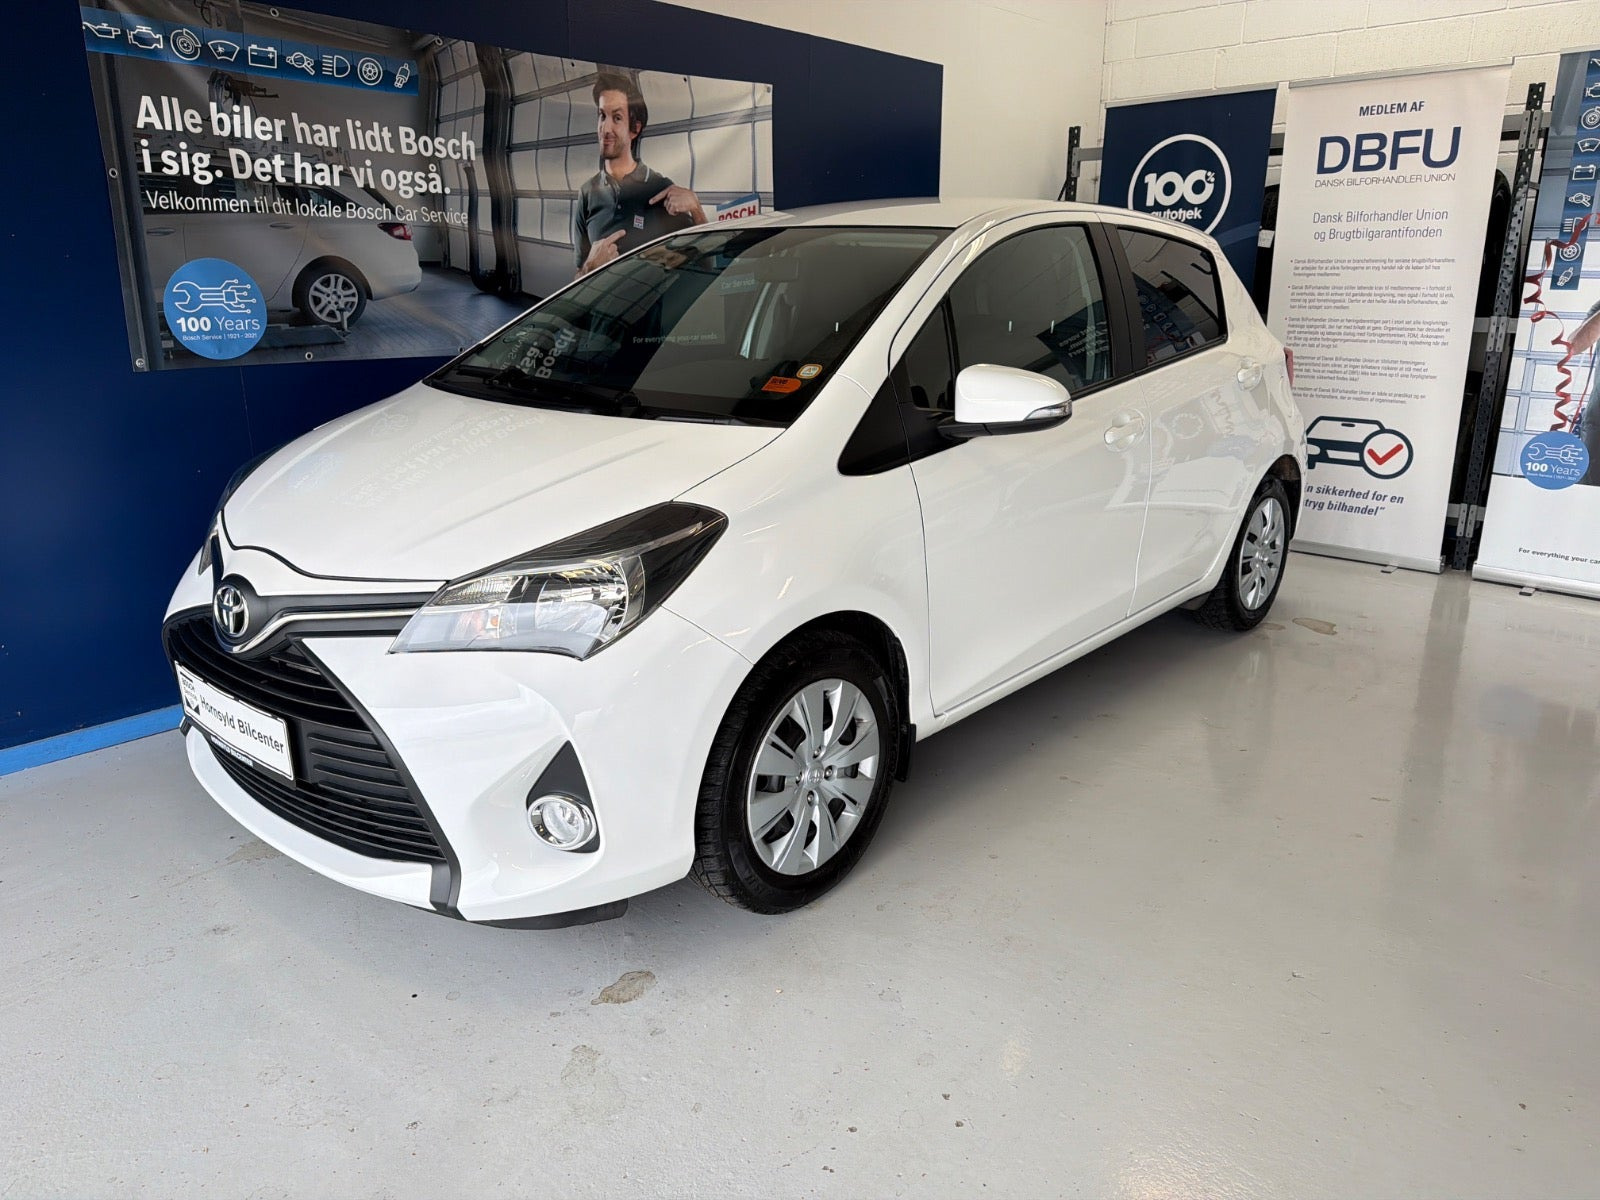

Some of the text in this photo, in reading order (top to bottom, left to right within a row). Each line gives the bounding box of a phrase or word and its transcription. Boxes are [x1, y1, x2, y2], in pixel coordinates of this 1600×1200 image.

[1359, 100, 1425, 117] MEDLEM AF
[136, 95, 476, 161] Alle biler har lidt Bosch
[1316, 126, 1462, 175] DBFU
[140, 138, 451, 199] i sig. Det har vi også.
[1144, 169, 1215, 207] 100%
[1314, 172, 1457, 188] DANSK BILFORHANDLER UNION
[146, 190, 469, 225] Velkommen til dit lokale Bosch Car Service
[1313, 207, 1449, 224] Dansk Bilforhandler Union
[1313, 226, 1442, 242] og Brugtbilgarantifonden
[176, 316, 260, 332] 100 Years
[1525, 461, 1581, 477] 100 Years
[1316, 484, 1370, 500] sikkerhed
[1371, 490, 1388, 502] for
[1390, 494, 1404, 504] en
[1304, 498, 1325, 512] tryg
[1532, 549, 1570, 561] everything
[1571, 556, 1588, 564] your
[199, 694, 236, 729] Hornsyld
[237, 719, 284, 754] Bilcenter
